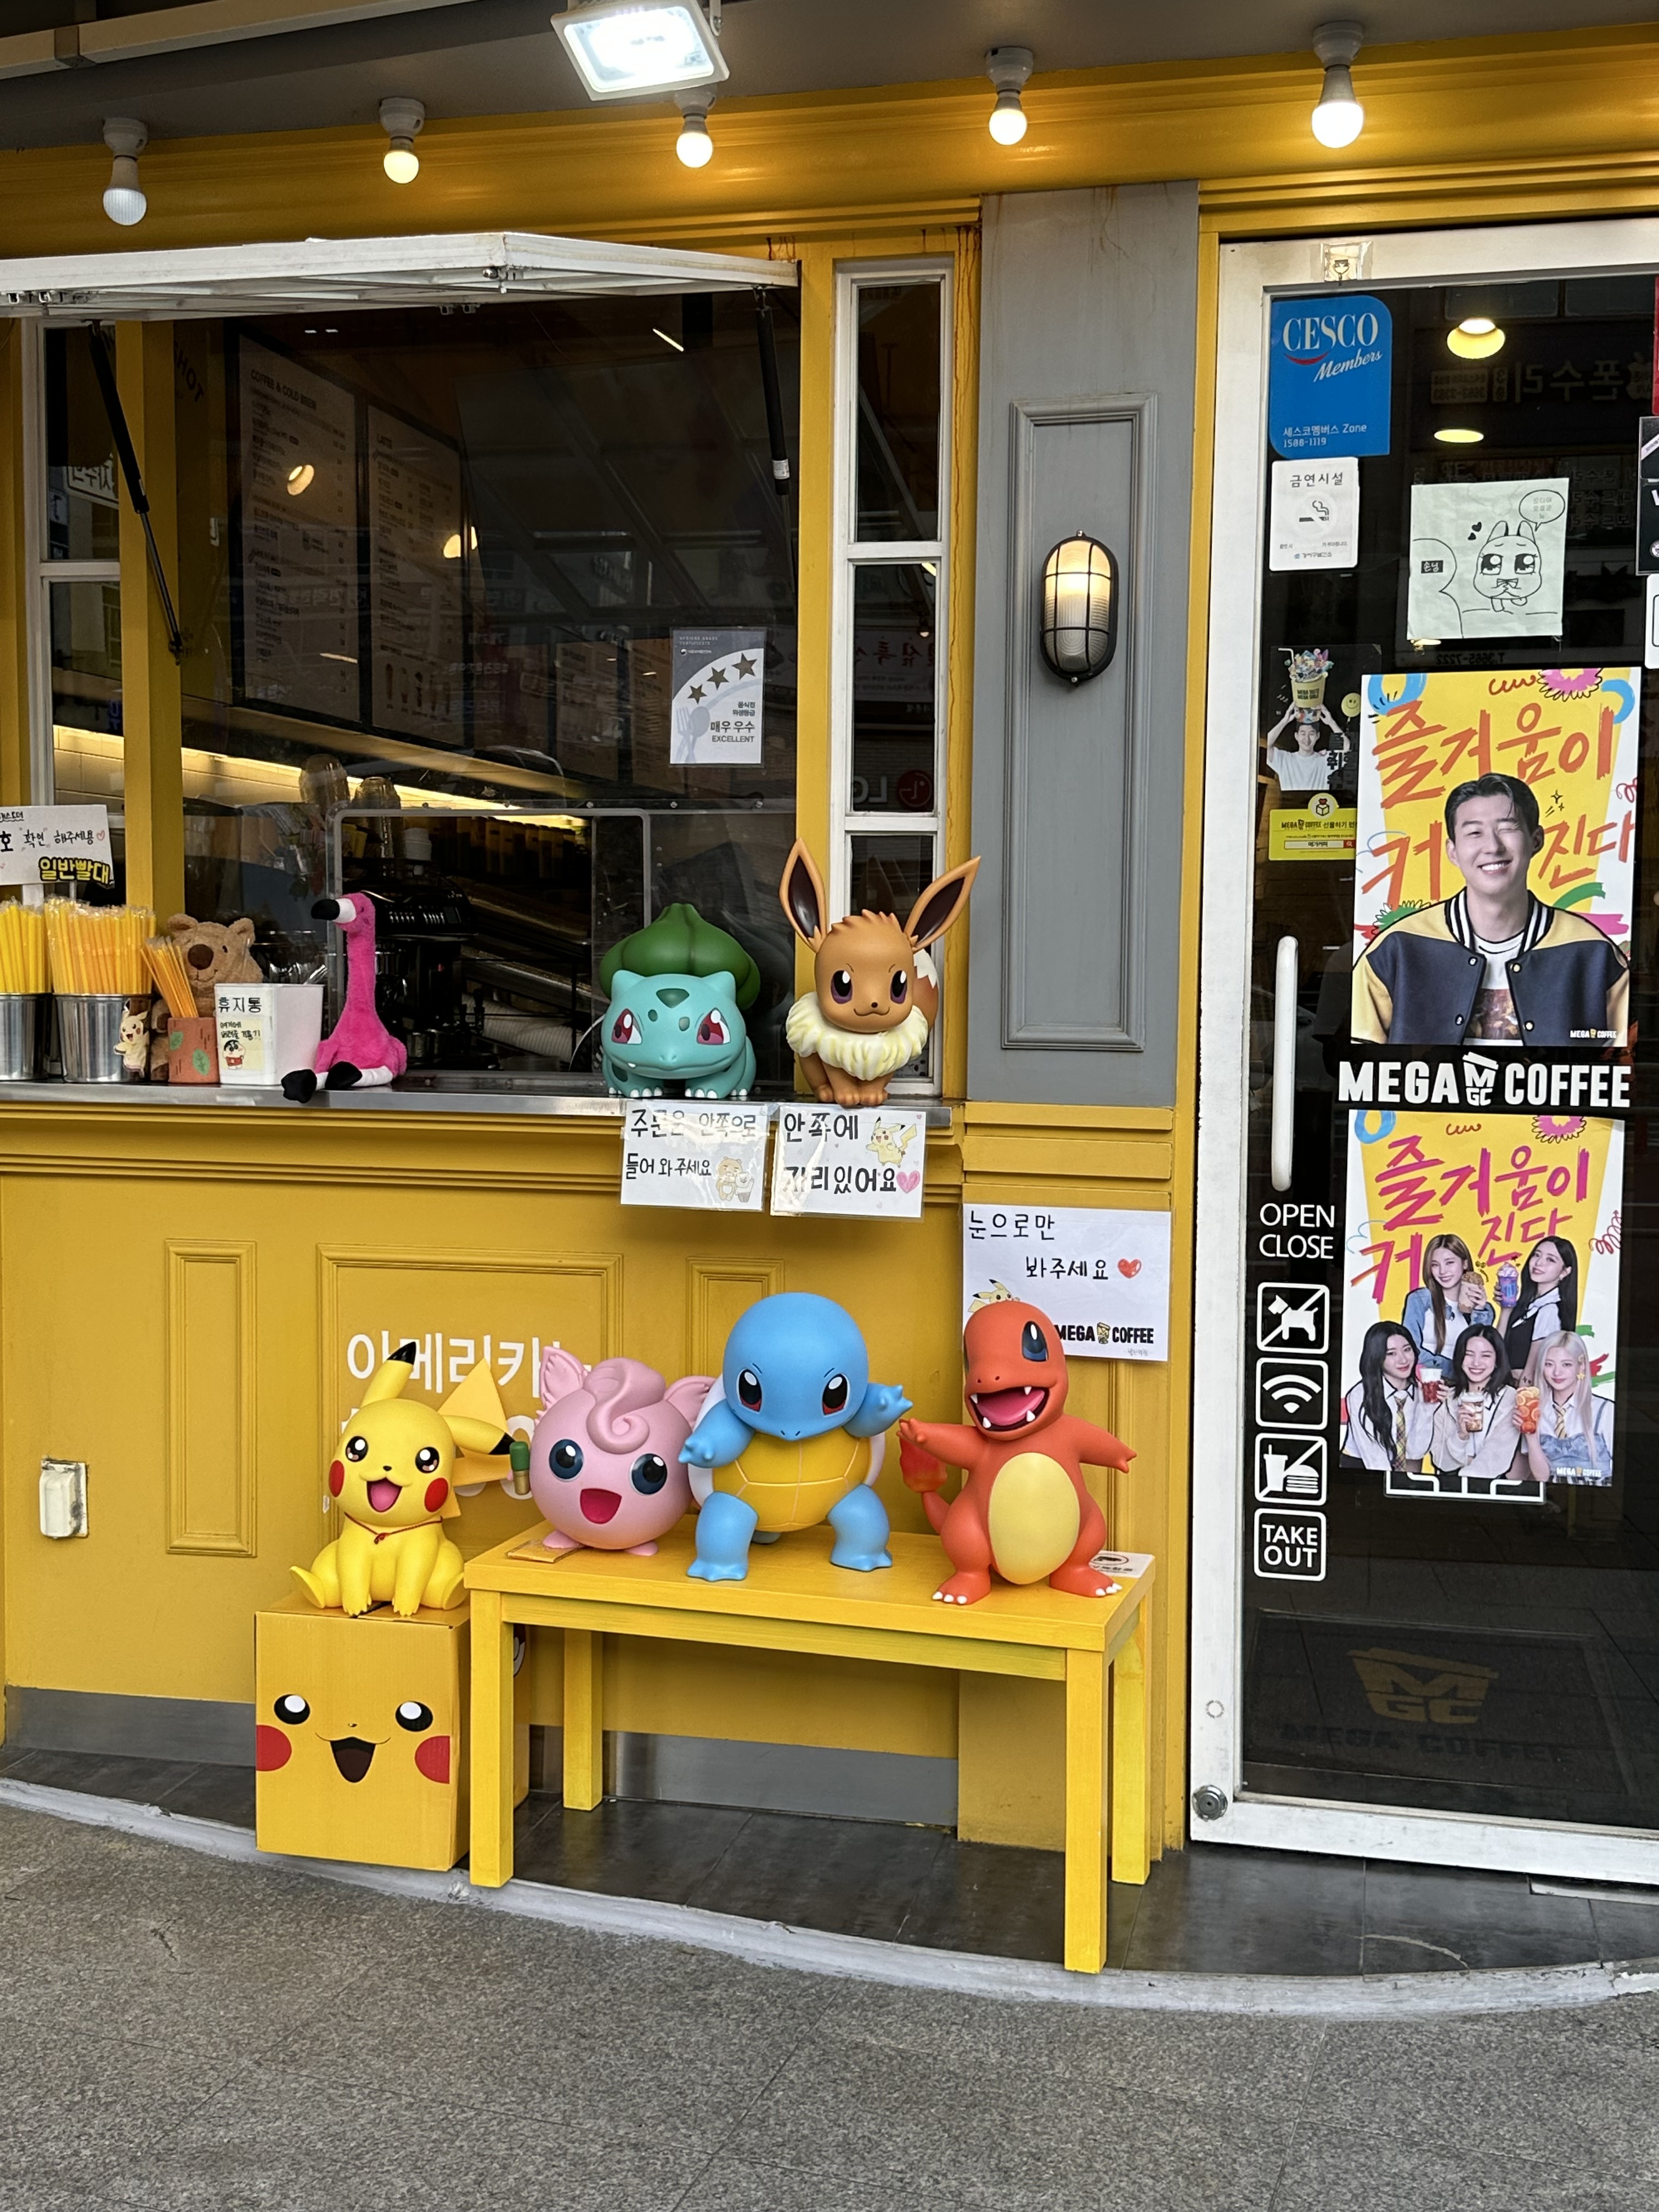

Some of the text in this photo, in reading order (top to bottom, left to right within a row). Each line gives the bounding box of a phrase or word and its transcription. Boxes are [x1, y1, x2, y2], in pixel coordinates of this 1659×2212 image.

[1283, 313, 1379, 351] CESCO
[1313, 348, 1383, 383] Members
[1283, 424, 1368, 438] 세스코멤버스 Zone
[1283, 437, 1327, 448] 1588-1119
[1290, 472, 1344, 488] 금연시설
[1423, 561, 1440, 573] 손님
[710, 720, 755, 733] 매우 우수
[712, 735, 755, 743] EXCELLENT
[1372, 701, 1615, 810] 즐거움이
[23, 829, 46, 848] 확인
[53, 830, 94, 845] 해주세용
[1538, 810, 1636, 889] 진다
[39, 857, 110, 885] 일반빨대
[218, 997, 262, 1013] 휴지통
[1570, 1029, 1617, 1039] MEGA COFFEE
[1338, 1061, 1460, 1104] MEGA
[1505, 1063, 1632, 1108] COFFEE
[631, 1109, 757, 1138] 주문은 안쪽으로
[1375, 1135, 1590, 1231] 즐거움이
[968, 1210, 1056, 1240] 눈으로만
[1260, 1203, 1335, 1228] OPEN
[1259, 1233, 1334, 1259] CLOSE
[1478, 1208, 1573, 1267] 진다
[1026, 1256, 1109, 1280] 봐주세요
[1351, 1232, 1423, 1305] 커
[1054, 1324, 1154, 1344] MEGA COFFEE
[347, 1330, 591, 1399] 아메리카
[1556, 1466, 1576, 1476] MEGA
[1262, 1523, 1318, 1546] TAKE
[1263, 1545, 1318, 1568] OUT
